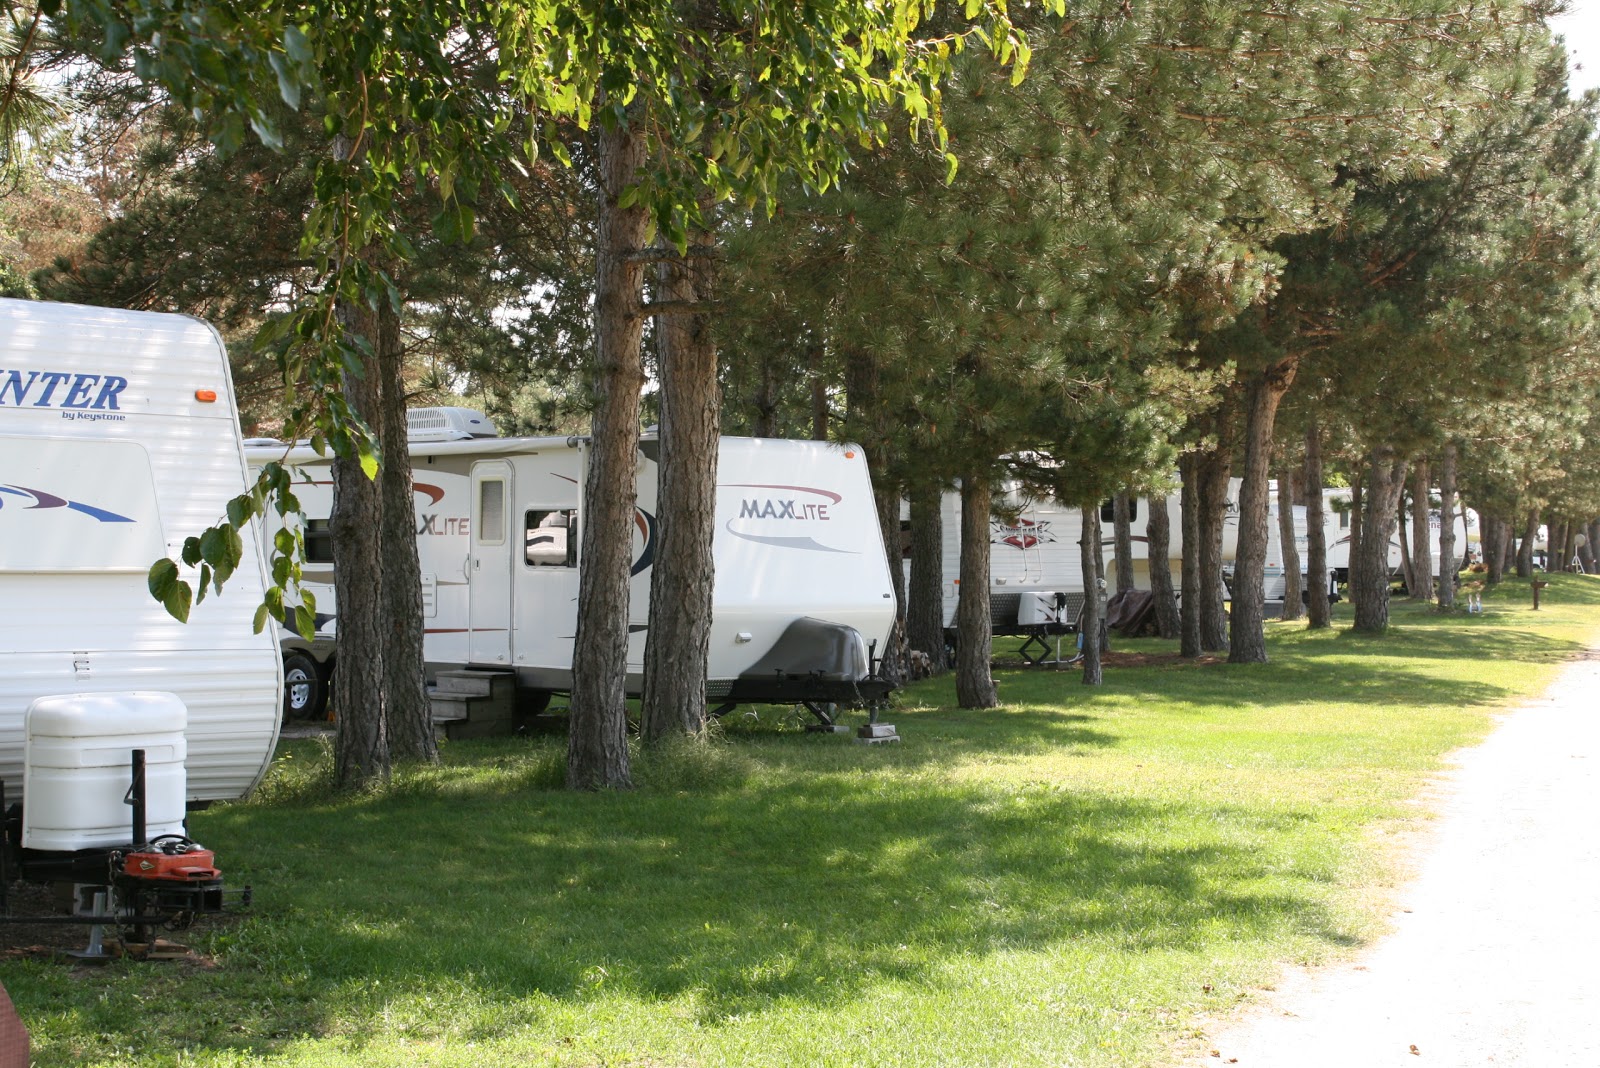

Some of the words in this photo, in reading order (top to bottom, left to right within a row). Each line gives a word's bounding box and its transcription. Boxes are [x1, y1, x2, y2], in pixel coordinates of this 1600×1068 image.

[0, 370, 128, 410] NTER
[62, 411, 75, 421] by
[77, 411, 126, 422] Keystone
[416, 513, 470, 535] XLITE
